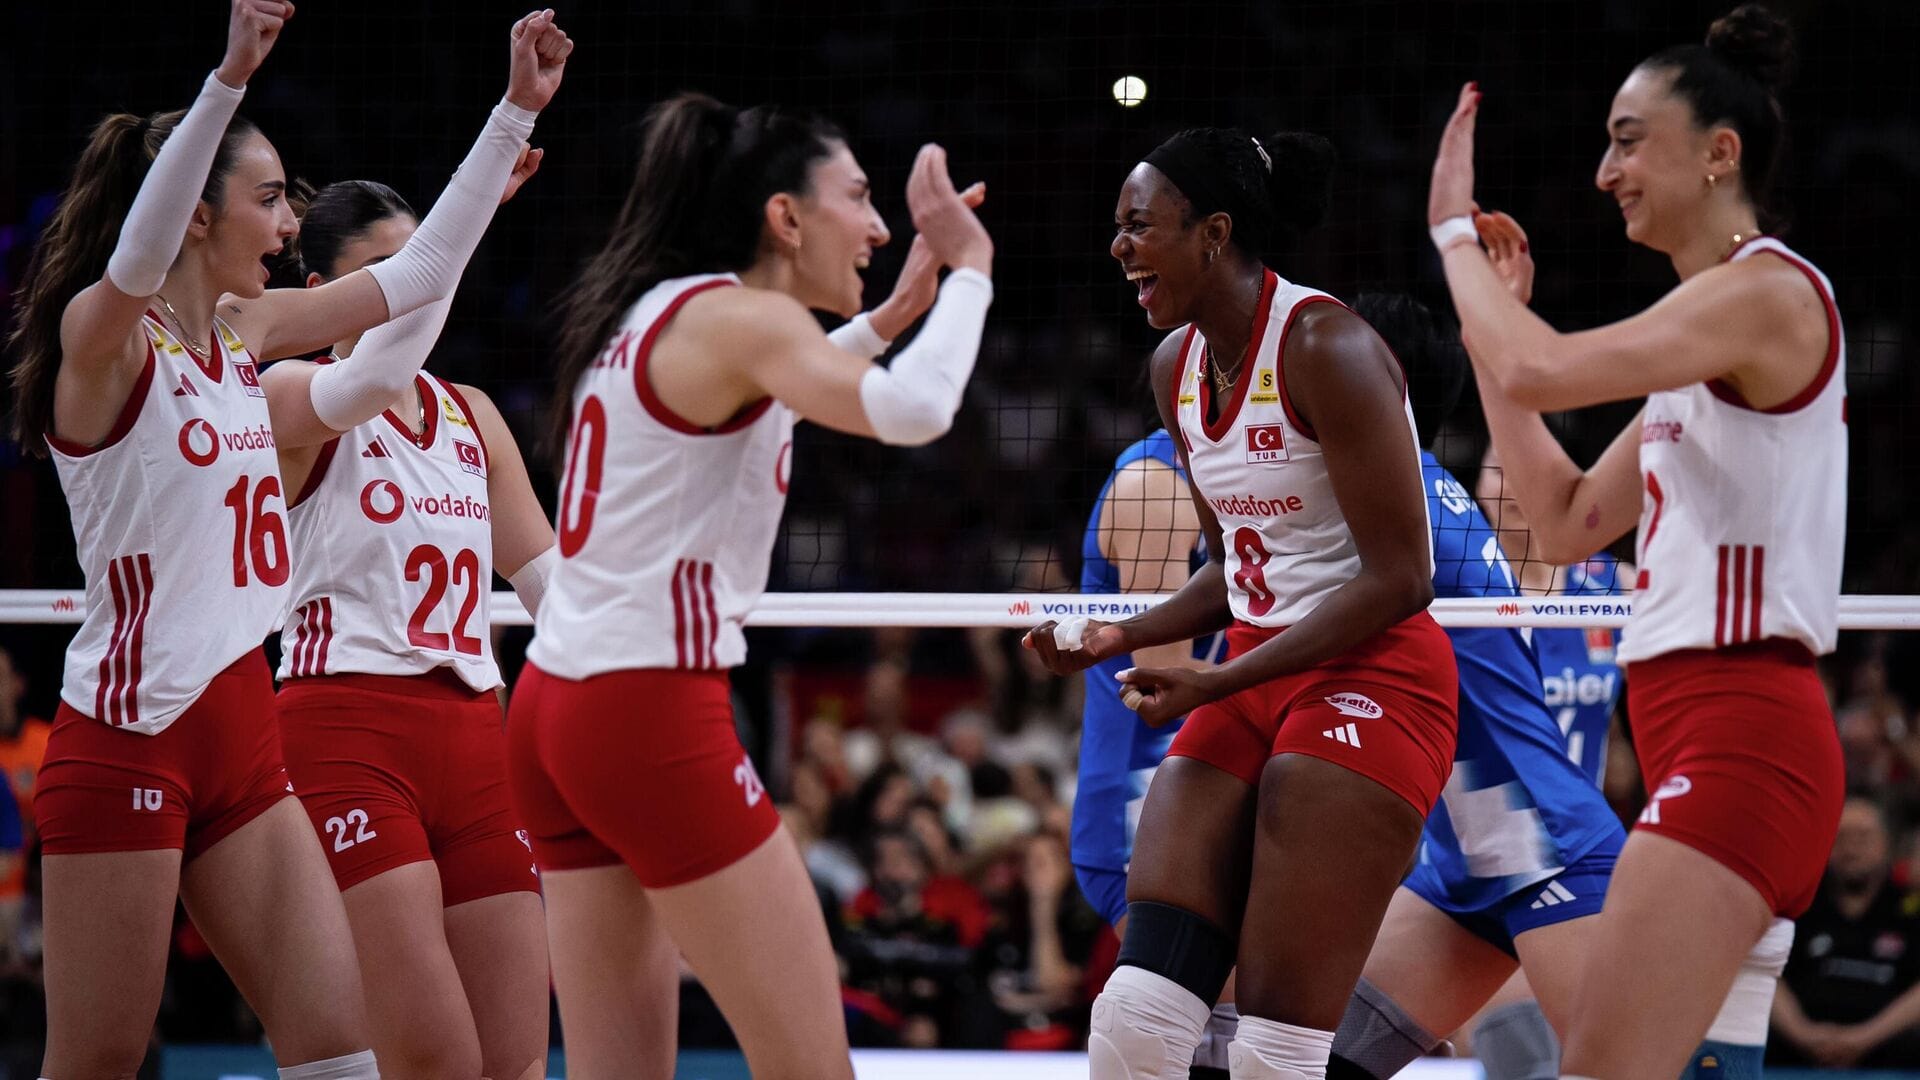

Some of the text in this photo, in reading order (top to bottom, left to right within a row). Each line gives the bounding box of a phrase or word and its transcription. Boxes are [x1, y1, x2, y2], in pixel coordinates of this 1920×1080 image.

[1263, 374, 1272, 387] S
[1256, 451, 1277, 461] TUR
[1210, 494, 1304, 517] vodafone
[224, 474, 290, 587] 16
[1234, 526, 1276, 618] 8
[404, 543, 483, 657] 22
[325, 808, 377, 853] 22
